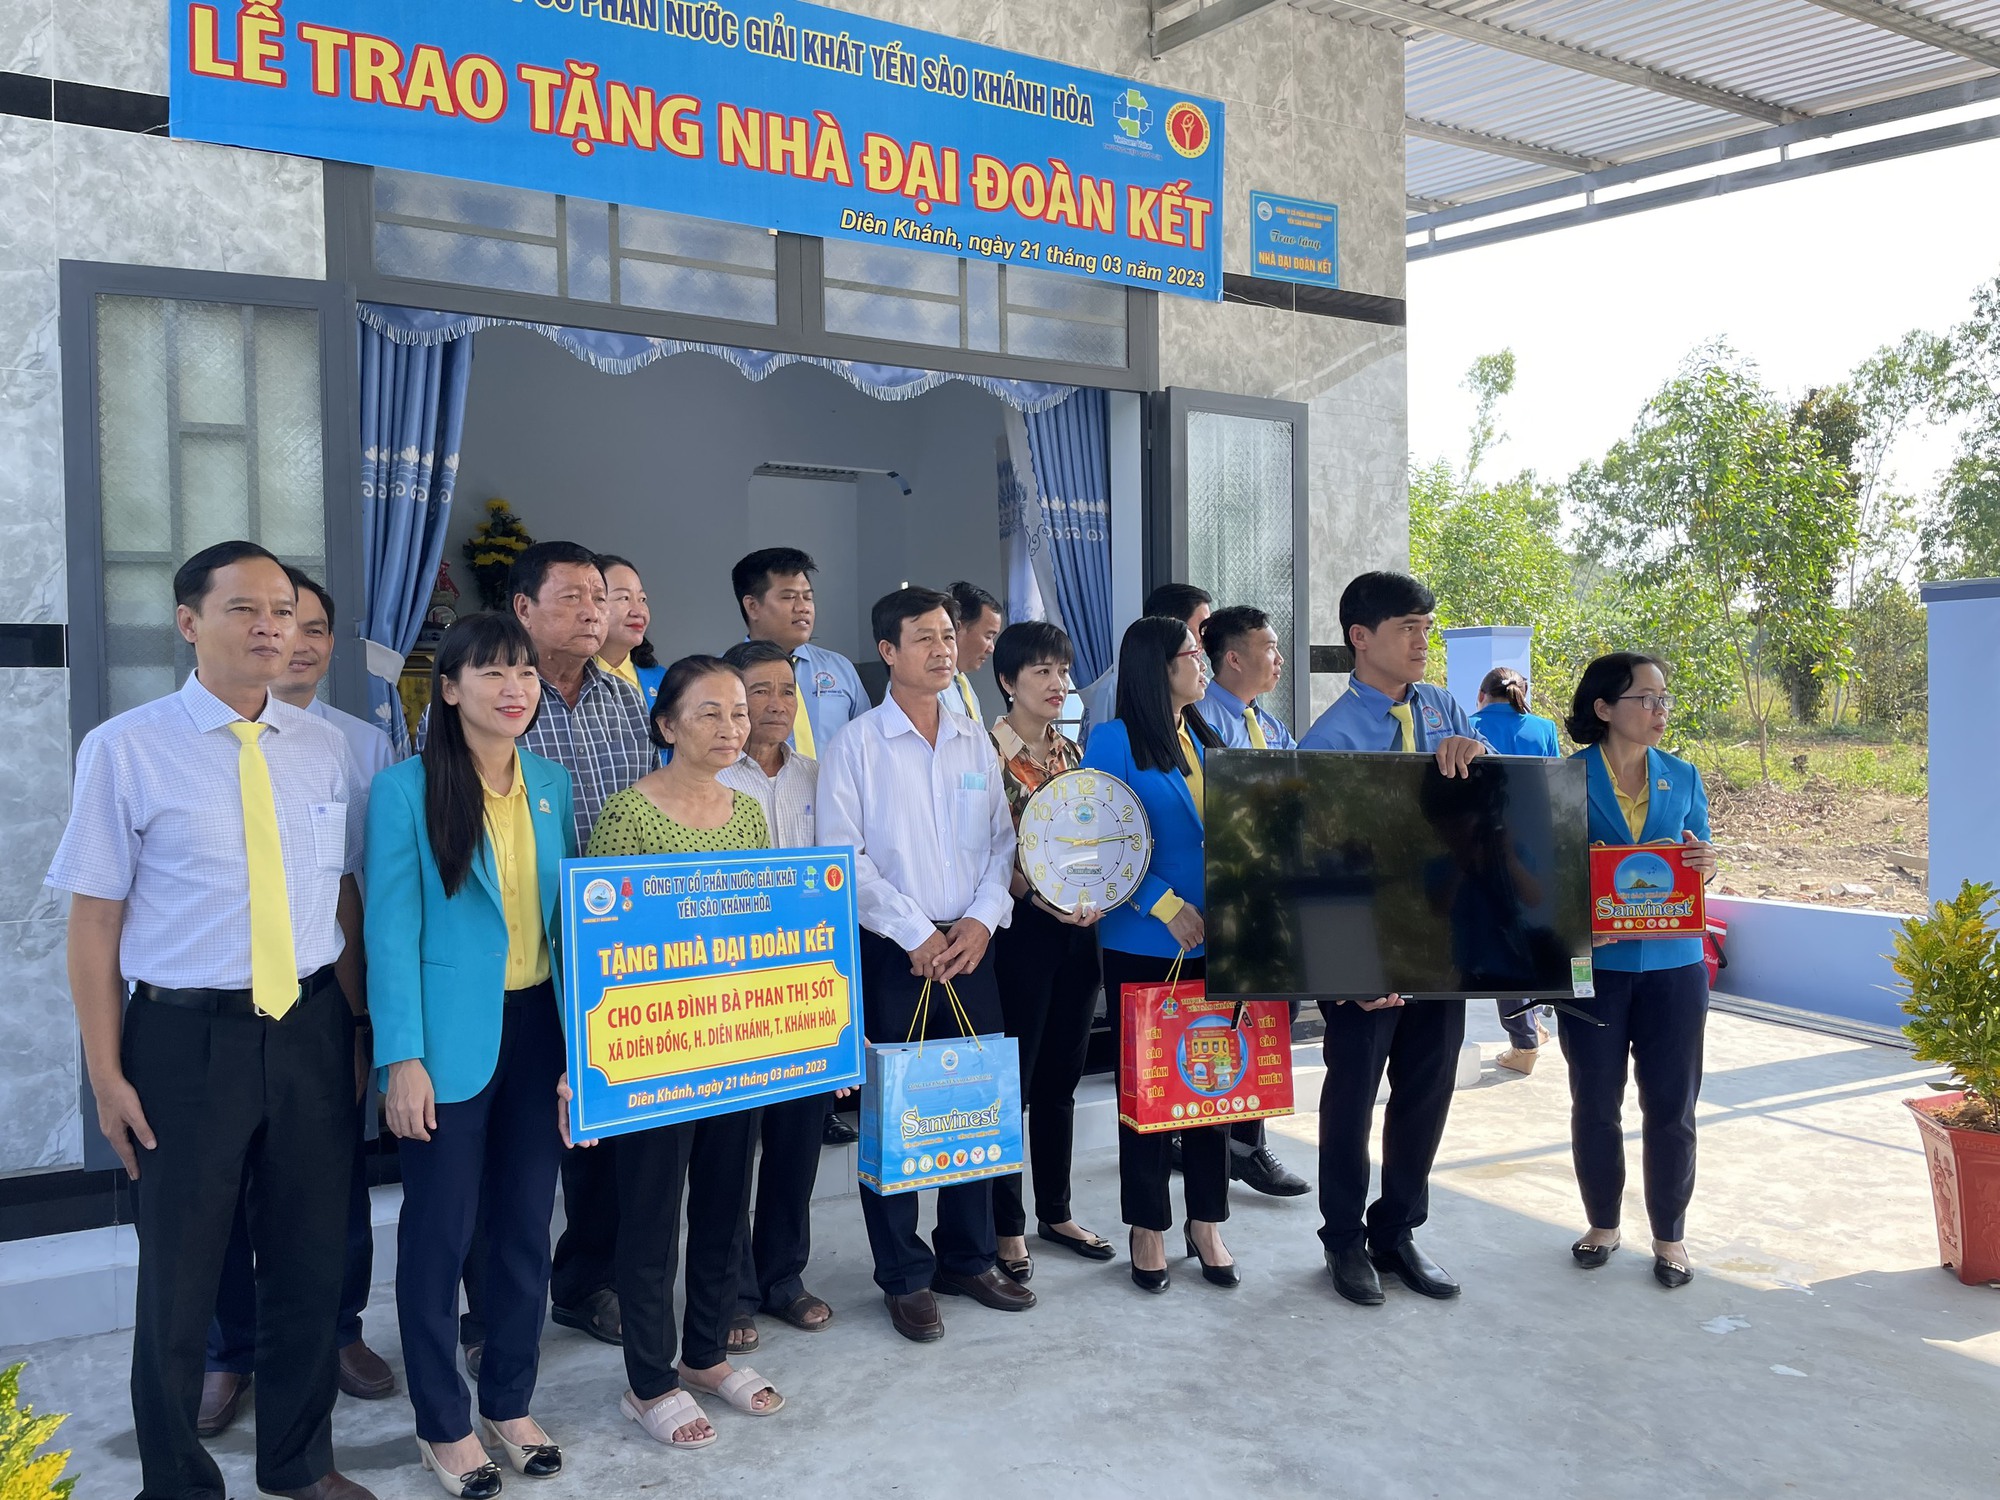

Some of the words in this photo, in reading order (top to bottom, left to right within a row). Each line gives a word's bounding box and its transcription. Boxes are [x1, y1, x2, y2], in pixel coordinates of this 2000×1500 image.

[666, 1, 738, 48] NƯỚC
[745, 12, 796, 62] GIẢI
[802, 31, 866, 76] KHÁT
[869, 40, 917, 88] YẾN
[922, 54, 968, 98] SÀO
[973, 69, 1047, 117] KHÁNH
[1051, 84, 1095, 127] HÒA
[190, 0, 286, 87] LỄ
[299, 22, 506, 123] TRAO
[518, 59, 703, 156] TẶNG
[717, 104, 853, 186] NHÀ
[862, 134, 960, 216] ĐẠI
[971, 156, 1115, 234] ĐOÀN
[1128, 180, 1212, 251] KẾT
[1270, 229, 1296, 242] Trao
[840, 208, 887, 236] Diên
[892, 218, 963, 250] Khánh,
[968, 235, 1016, 260] ngày
[1020, 240, 1041, 260] 21
[1046, 245, 1097, 274] tháng
[1101, 254, 1123, 274] 03
[1126, 260, 1162, 282] năm
[1166, 266, 1205, 288] 2023
[1258, 251, 1276, 266] NHÀ
[1278, 254, 1292, 270] ĐẠI
[1317, 258, 1332, 274] KẾT
[1050, 782, 1068, 800] 11
[1075, 777, 1096, 795] 12
[1105, 784, 1113, 801] 1
[1031, 802, 1051, 820] 10
[1122, 805, 1134, 822] 2
[1025, 833, 1038, 850] 9
[1131, 833, 1142, 851] 3
[643, 875, 672, 896] CÔNG
[673, 876, 685, 894] TY
[687, 869, 701, 893] CỔ
[730, 869, 755, 891] NƯỚC
[757, 866, 774, 889] GIẢI
[775, 866, 797, 887] KHÁT
[1034, 863, 1046, 881] 8
[1121, 863, 1134, 881] 4
[1052, 883, 1064, 901] 7
[1106, 883, 1117, 900] 5
[678, 896, 698, 919] YẾN
[700, 894, 719, 916] SÀO
[720, 893, 752, 915] KHÁNH
[753, 891, 772, 913] HÒA
[1596, 894, 1692, 920] Sanvinest
[598, 942, 658, 980] TẶNG
[663, 934, 708, 969] NHÀ
[712, 935, 746, 967] ĐẠI
[751, 926, 800, 959] ĐOÀN
[805, 920, 835, 953] KẾT
[607, 1005, 642, 1029] CHO
[646, 1001, 674, 1023] GIA
[677, 994, 717, 1019] ĐÌNH
[722, 988, 742, 1013] BÀ
[745, 985, 784, 1010] PHAN
[786, 982, 809, 1006] THỊ
[812, 976, 835, 999] SÓT
[1257, 1015, 1276, 1028] YẾN
[608, 1037, 624, 1062] XÃ
[626, 1033, 653, 1058] DIÊN
[656, 1029, 692, 1053] ĐỒNG,
[694, 1030, 706, 1048] H.
[708, 1023, 733, 1046] DIÊN
[735, 1018, 774, 1042] KHÁNH,
[774, 1017, 783, 1035] T.
[784, 1008, 817, 1034] KHÁNH
[818, 1006, 837, 1028] HÒA
[1145, 1026, 1162, 1040] YẾN
[1259, 1034, 1276, 1047] SÀO
[1146, 1048, 1162, 1059] SÀO
[1257, 1054, 1282, 1066] THIÊN
[1143, 1066, 1169, 1079] KHÁNH
[1258, 1073, 1283, 1085] NHIÊN
[628, 1092, 655, 1108] Diên
[656, 1084, 696, 1103] Khánh,
[697, 1079, 723, 1097] ngày
[725, 1076, 737, 1090] 21
[740, 1072, 768, 1088] tháng
[770, 1067, 782, 1080] 03
[783, 1064, 804, 1079] năm
[805, 1059, 827, 1074] 2023
[1147, 1086, 1165, 1098] HÒA
[901, 1105, 1000, 1140] Sanvinest
